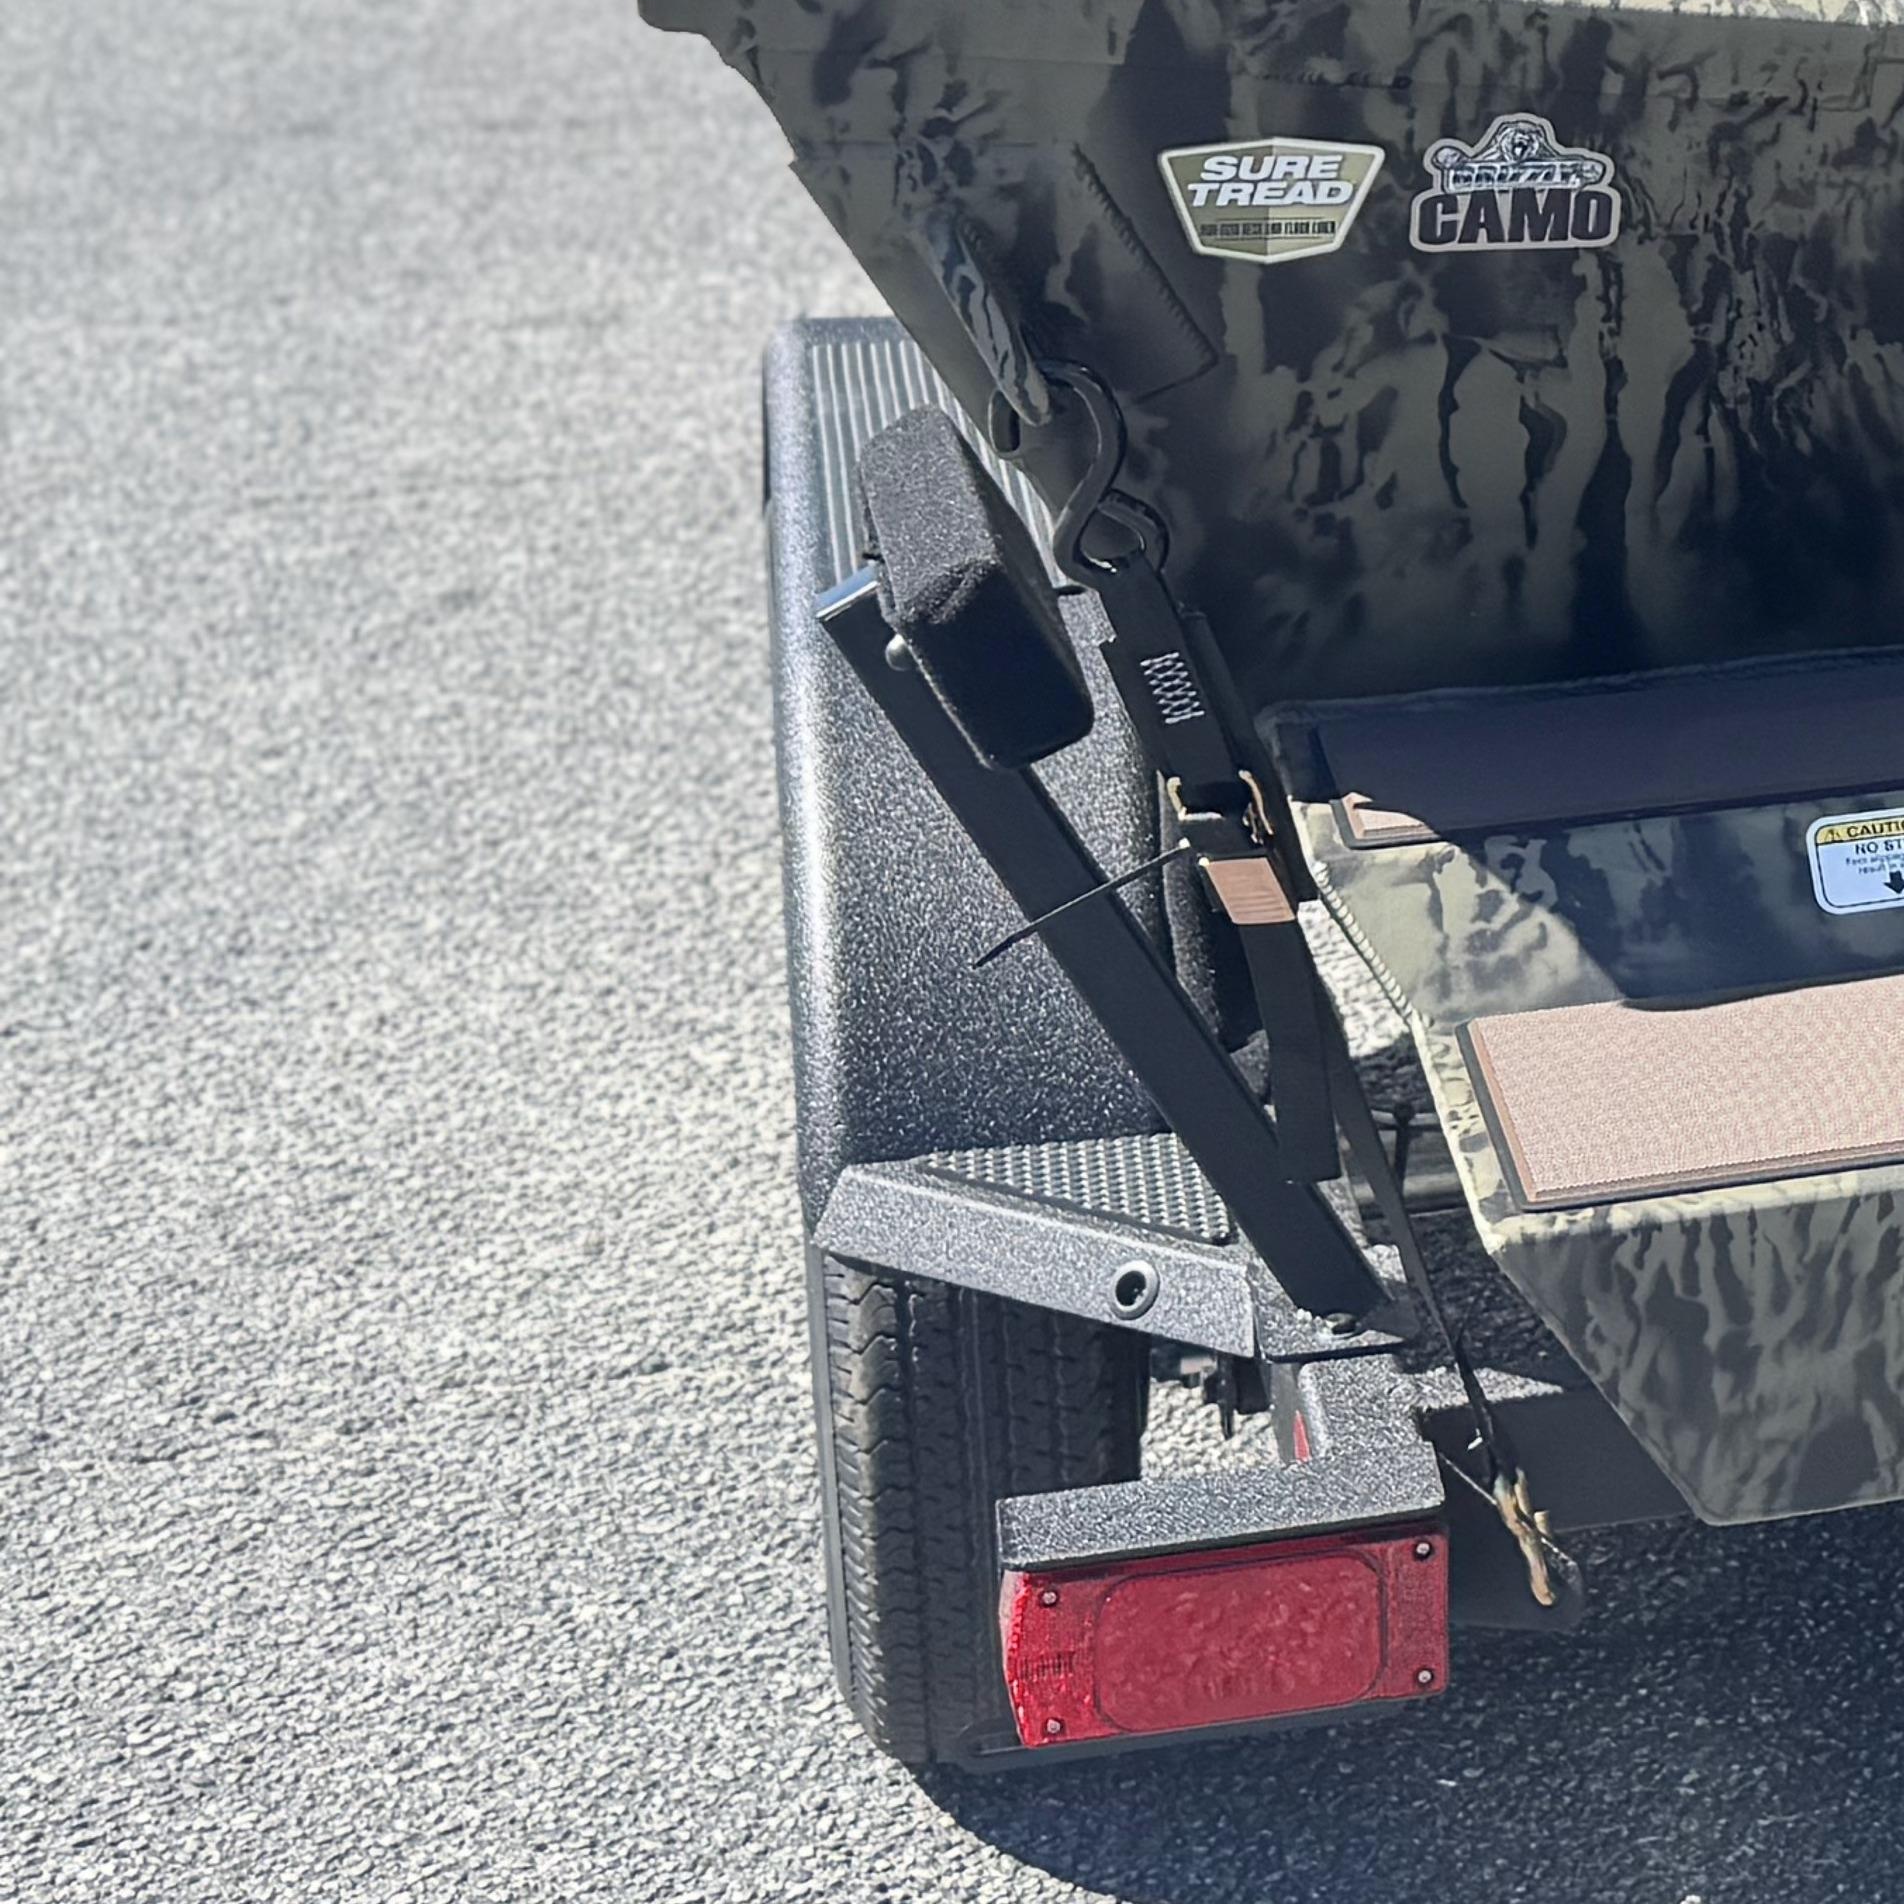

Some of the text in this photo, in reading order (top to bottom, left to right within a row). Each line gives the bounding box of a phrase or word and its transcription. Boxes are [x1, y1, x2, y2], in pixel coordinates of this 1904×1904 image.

[1200, 154, 1344, 181] SURE
[1187, 180, 1355, 207] TREAD
[1417, 188, 1613, 244] CAMO
[1855, 841, 1879, 855] NO
